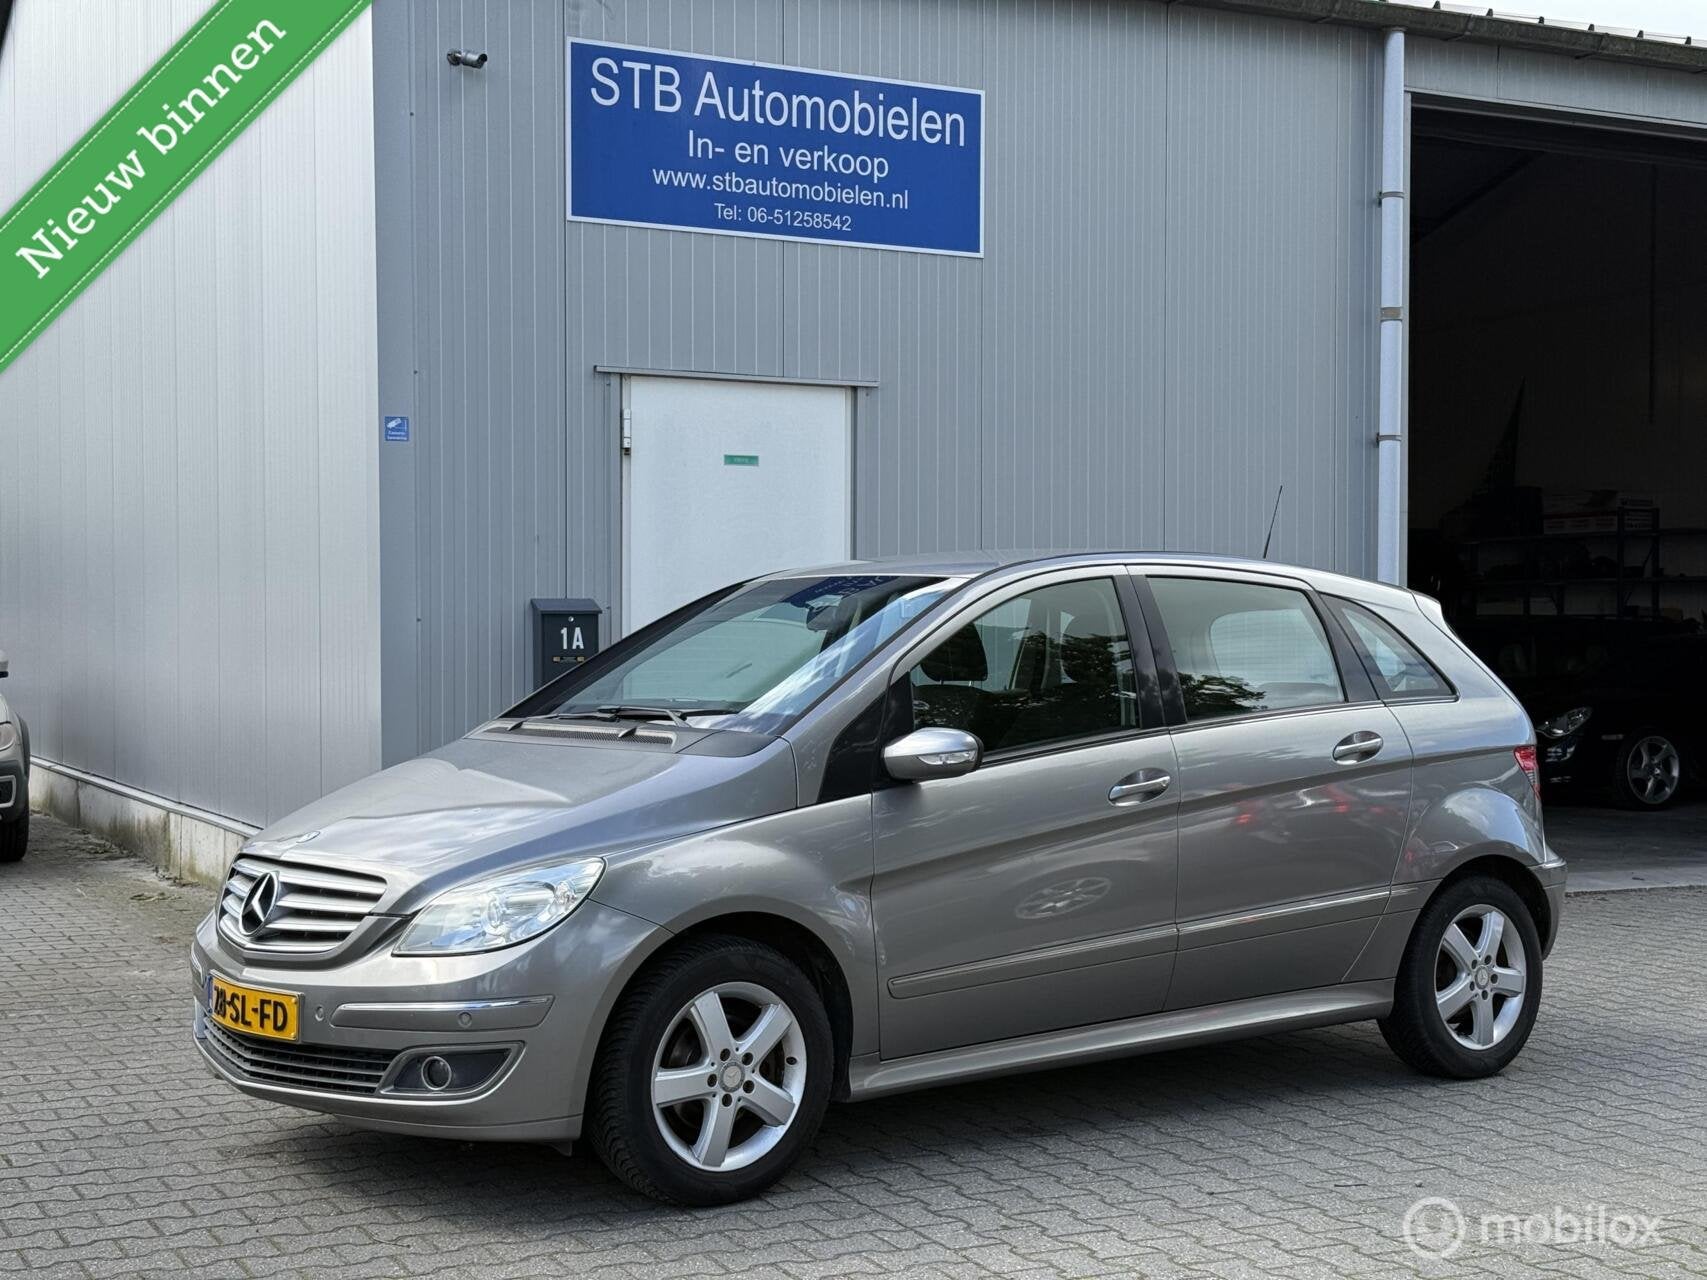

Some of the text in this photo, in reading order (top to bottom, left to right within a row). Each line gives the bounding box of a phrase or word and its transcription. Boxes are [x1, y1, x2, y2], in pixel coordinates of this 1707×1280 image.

[590, 57, 965, 147] STB Automobielen
[688, 130, 889, 183] In- en verkoop
[652, 168, 909, 209] www.stbautomobielen.nl
[714, 202, 852, 232] Tel: 06-51258542
[560, 627, 584, 650] 1A
